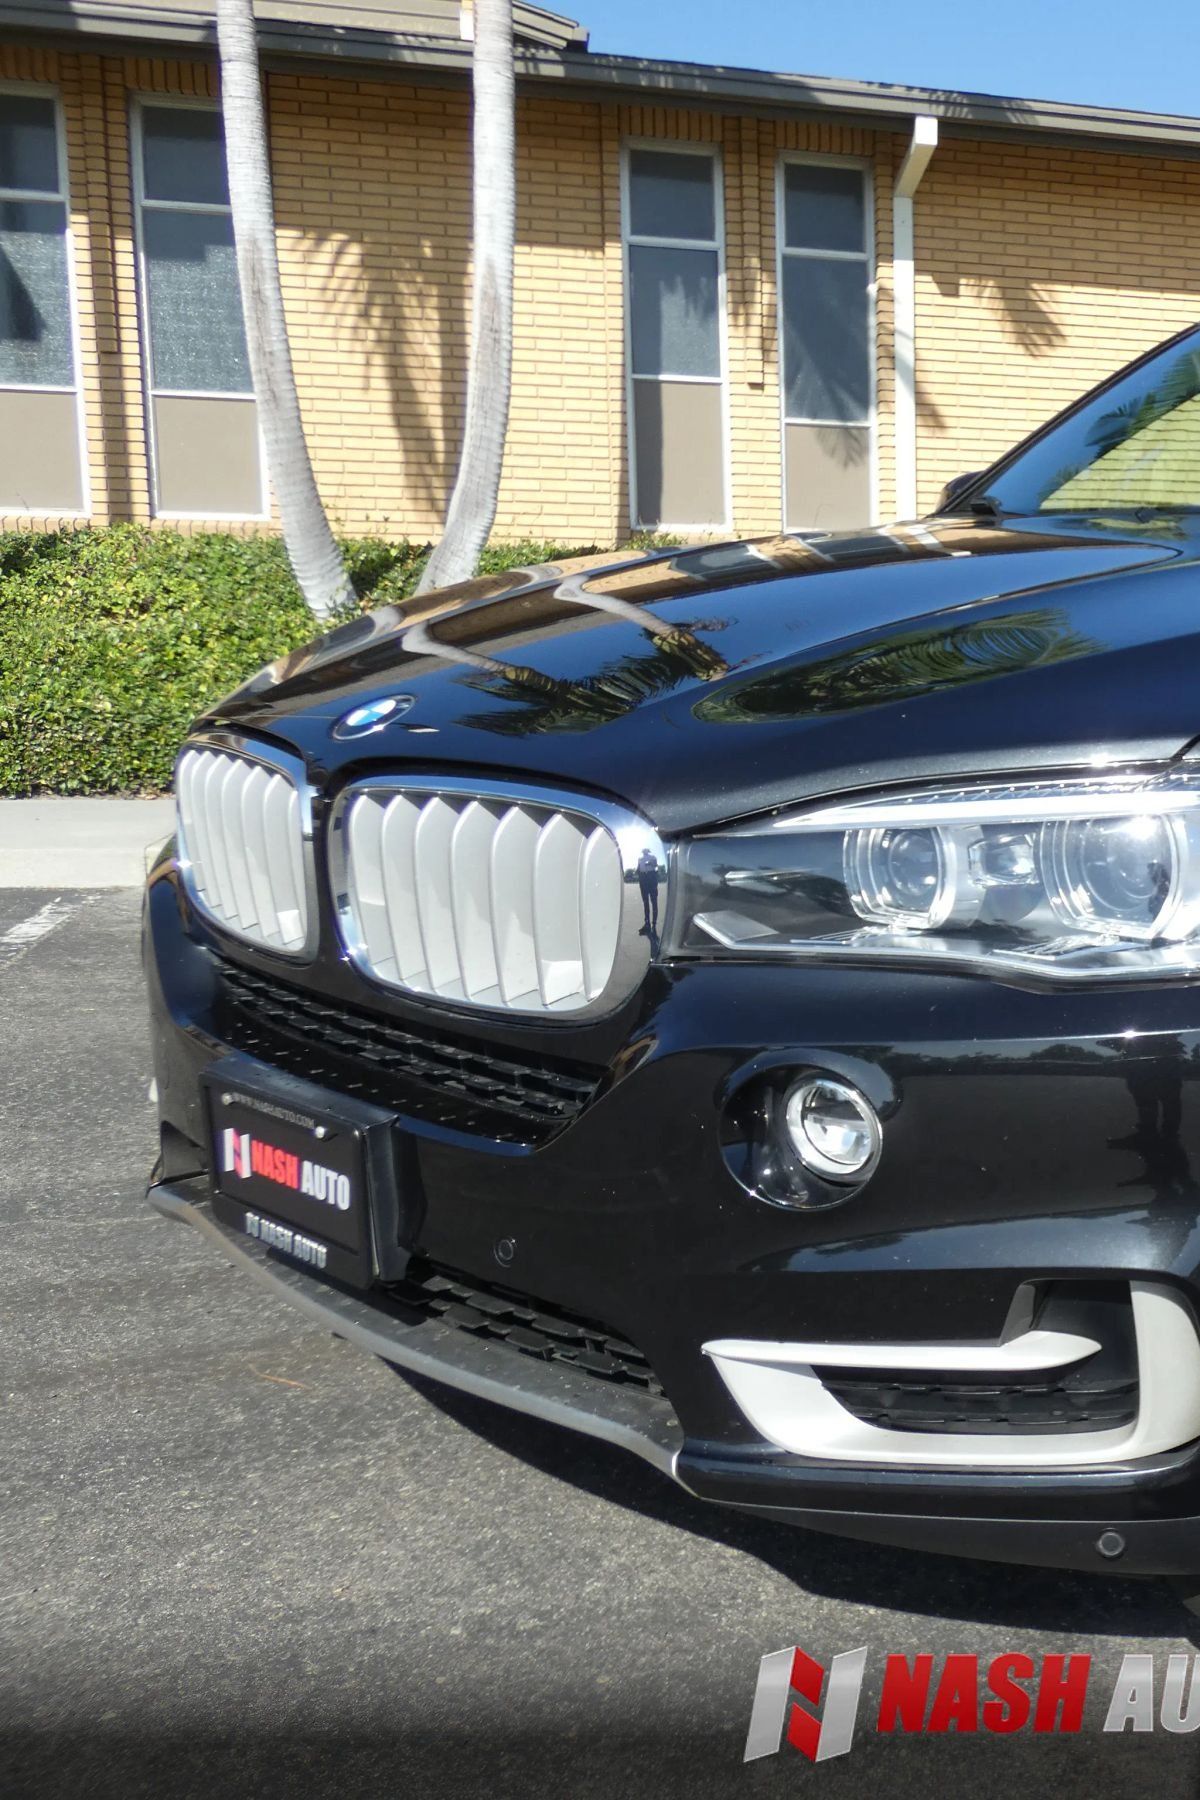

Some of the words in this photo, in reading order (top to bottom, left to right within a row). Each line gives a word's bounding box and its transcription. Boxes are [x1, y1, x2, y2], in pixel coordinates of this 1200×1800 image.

[251, 1139, 299, 1189] NASH
[302, 1160, 350, 1211] AUTO
[294, 1233, 328, 1269] AUTO
